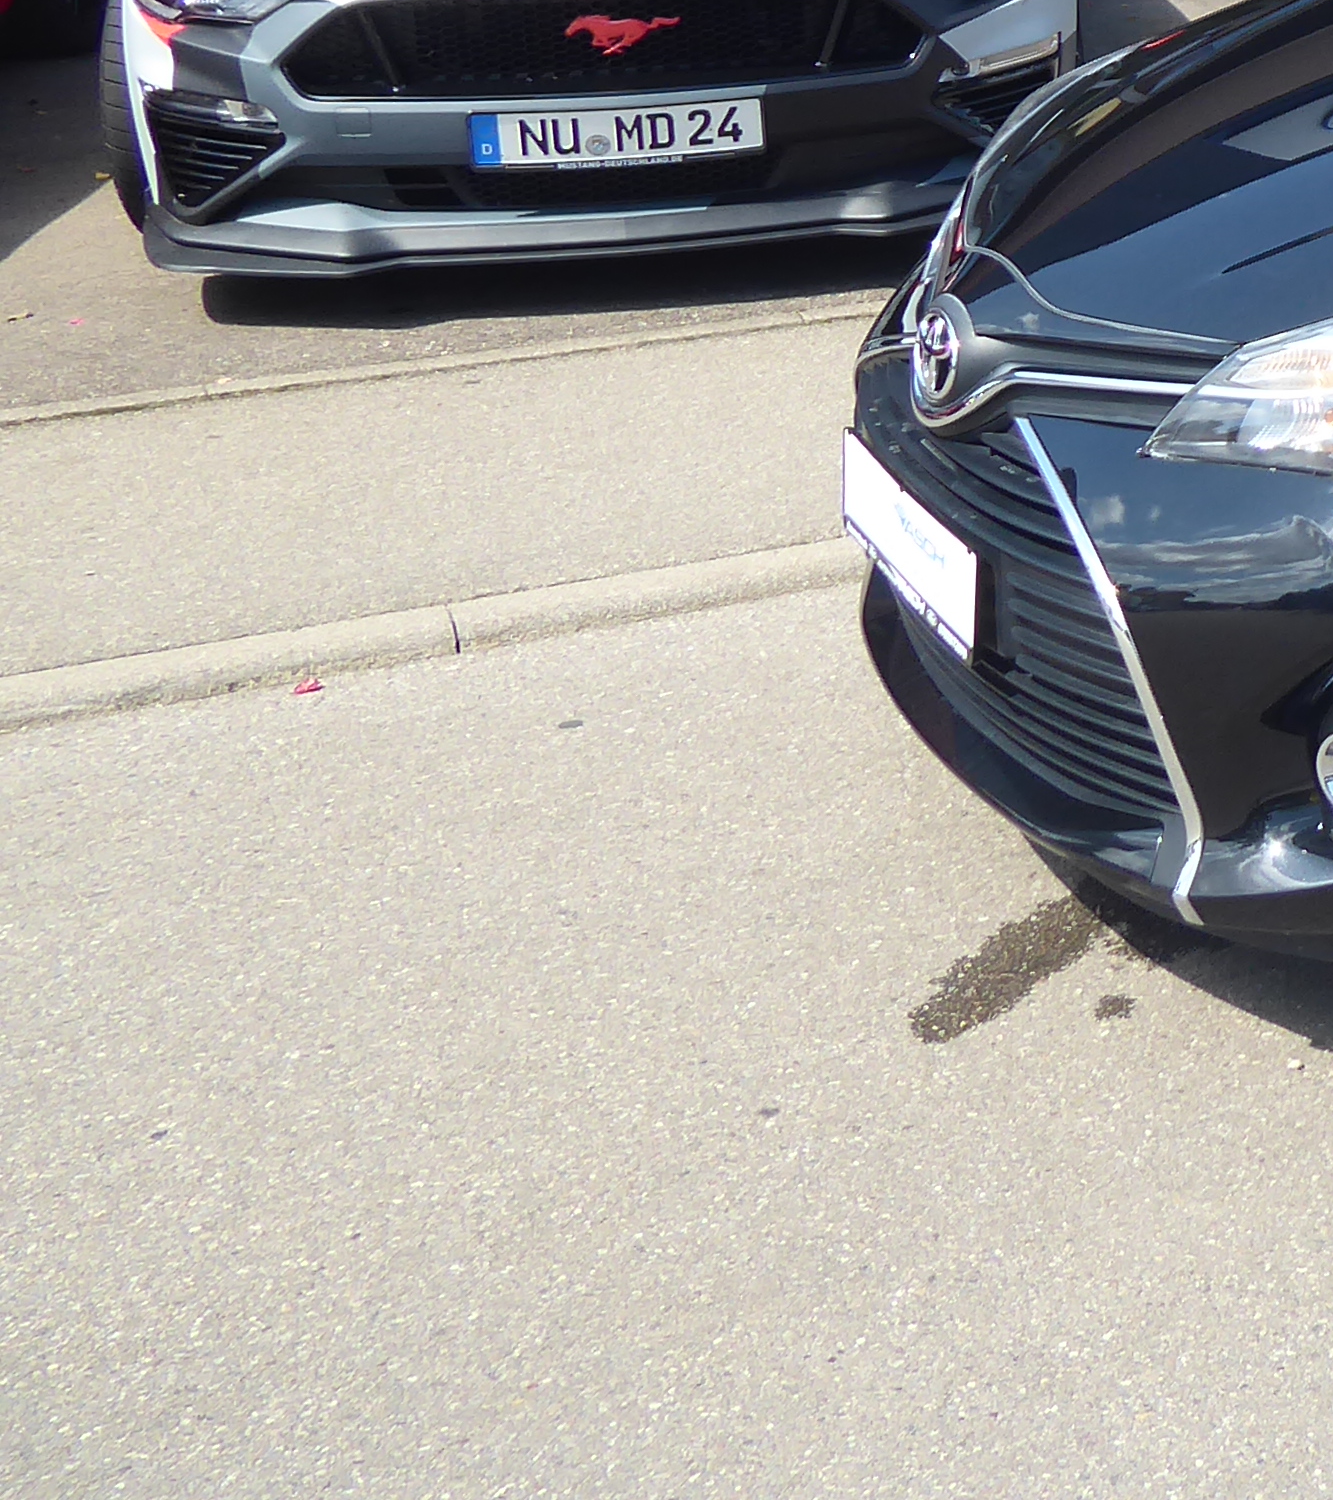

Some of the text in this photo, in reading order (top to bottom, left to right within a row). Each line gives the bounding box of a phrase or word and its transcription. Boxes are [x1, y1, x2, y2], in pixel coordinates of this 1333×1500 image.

[517, 106, 744, 156] NU MD 24
[481, 143, 494, 155] D
